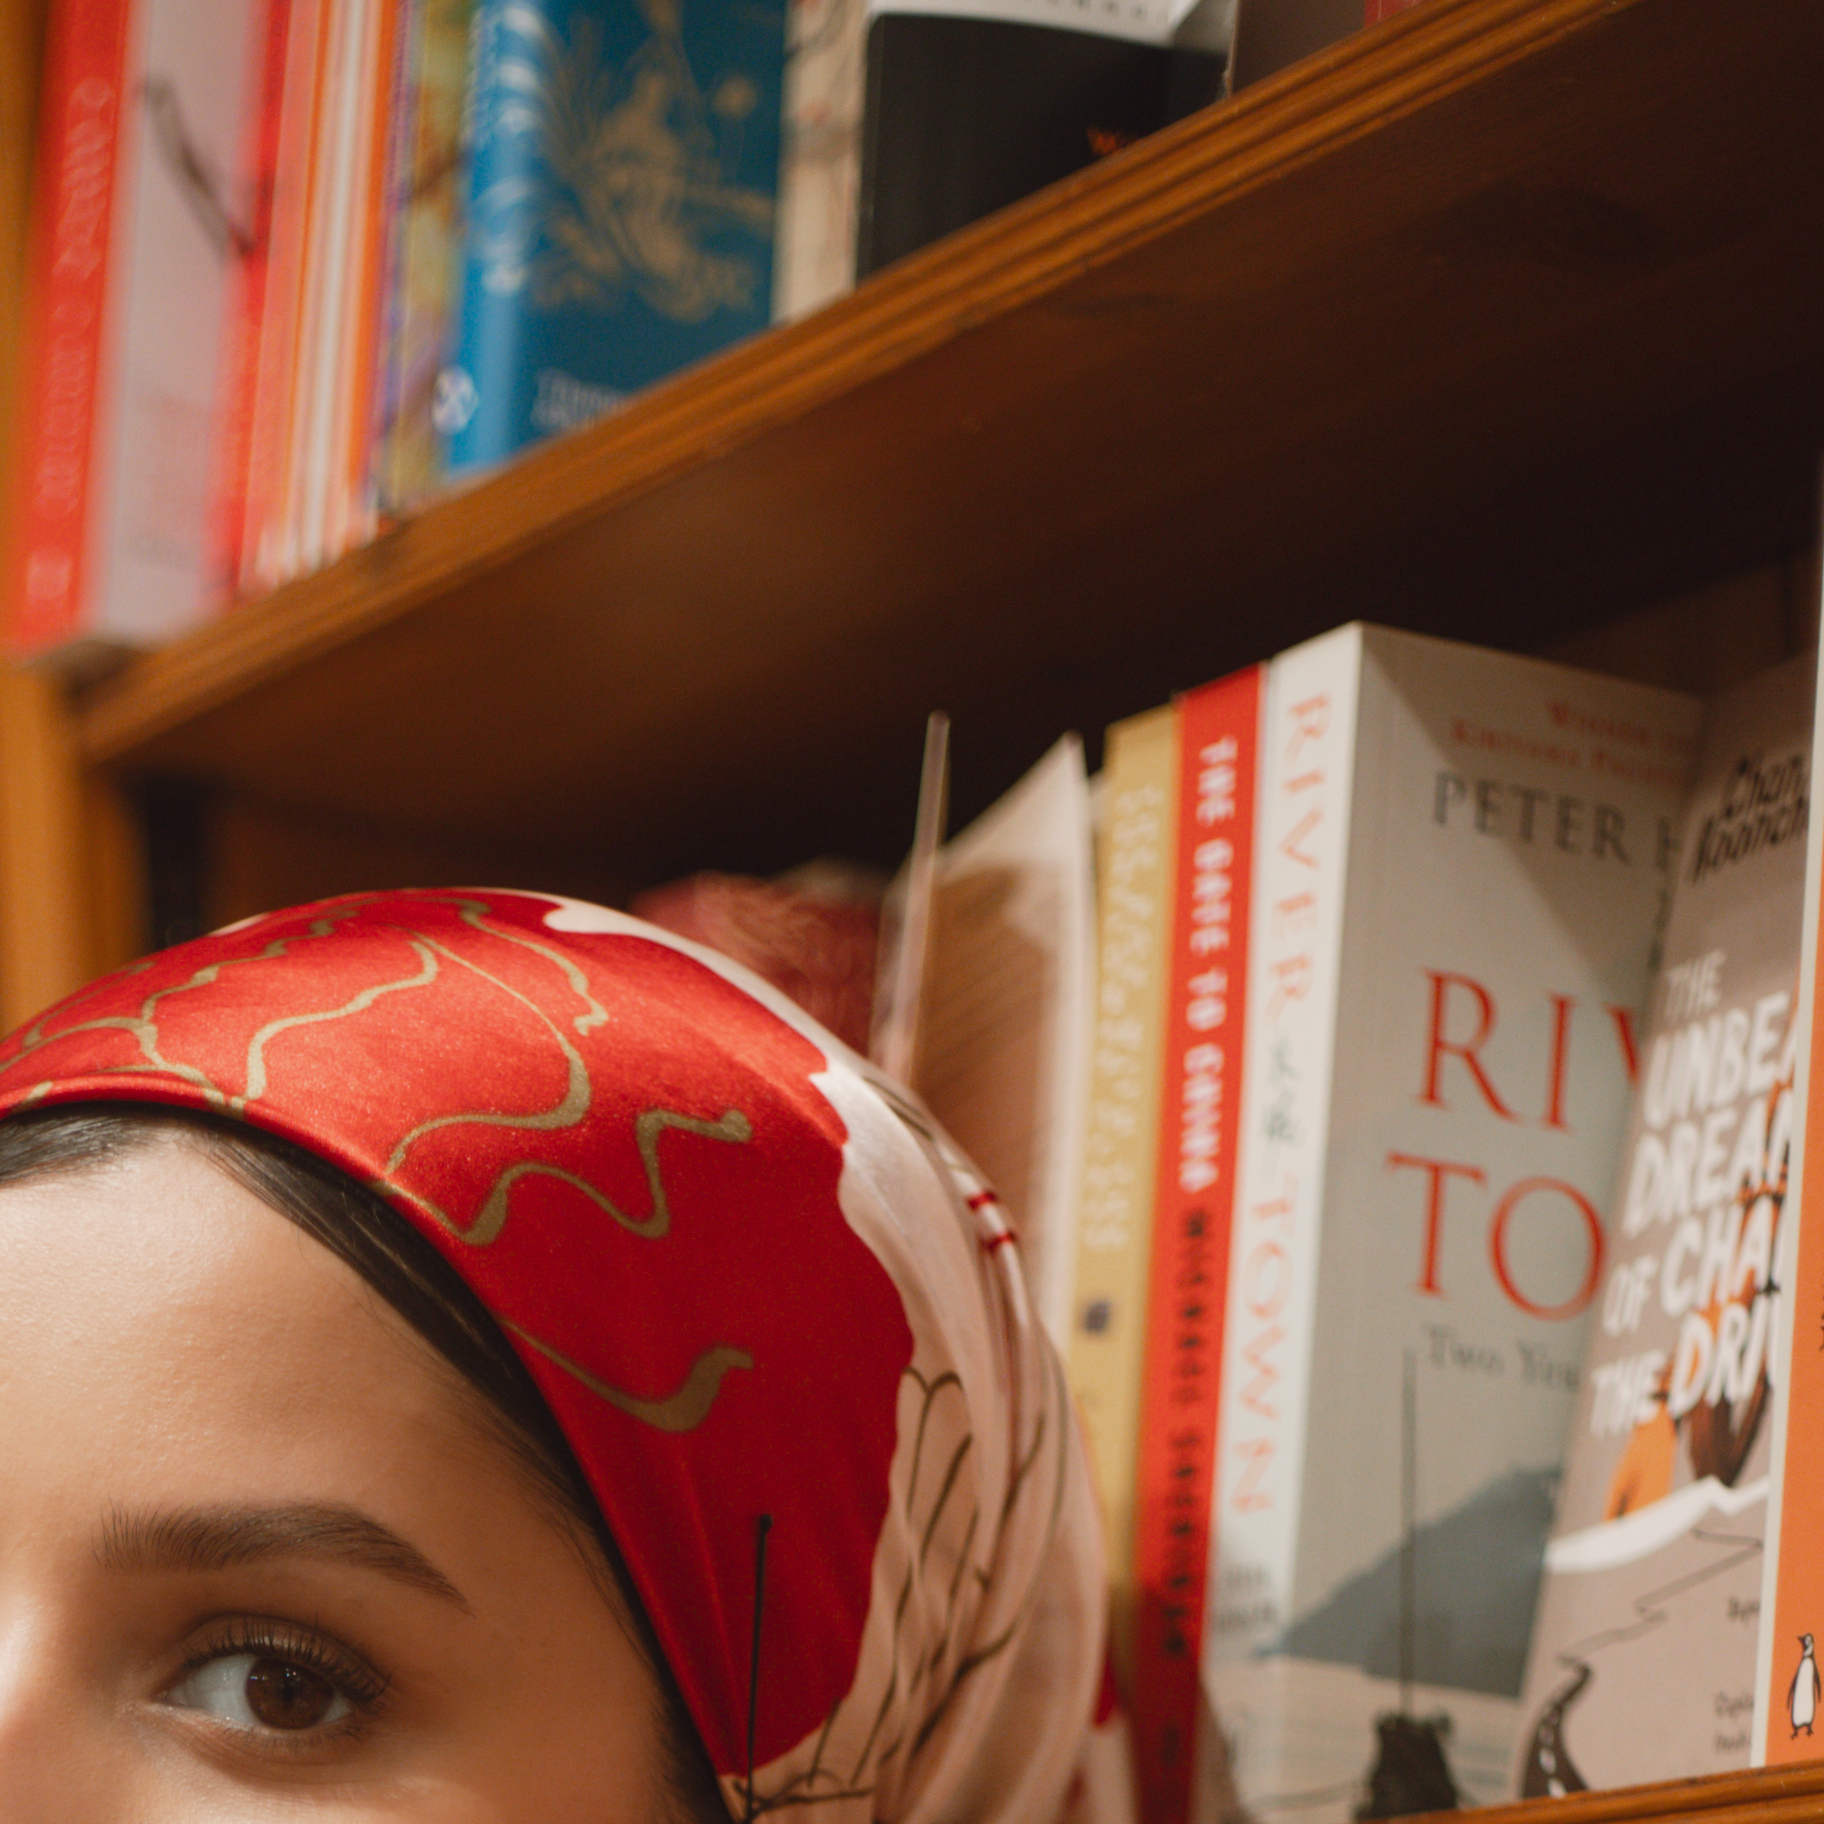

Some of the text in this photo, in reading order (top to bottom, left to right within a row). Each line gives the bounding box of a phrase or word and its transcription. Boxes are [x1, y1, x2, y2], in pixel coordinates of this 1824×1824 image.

[1195, 734, 1239, 828] THE
[1432, 768, 1631, 867] PETER
[1188, 837, 1235, 958] GATE
[1265, 692, 1333, 1026] RIVER
[1185, 966, 1229, 1032] TO
[1667, 948, 1728, 1018] THE
[1179, 1042, 1225, 1194] CHINA
[1384, 1150, 1610, 1324] TO
[1602, 1254, 1660, 1337] OF
[1660, 1194, 1786, 1319] CHA
[1231, 1169, 1299, 1515] TOWN
[1588, 1348, 1665, 1440] THE
